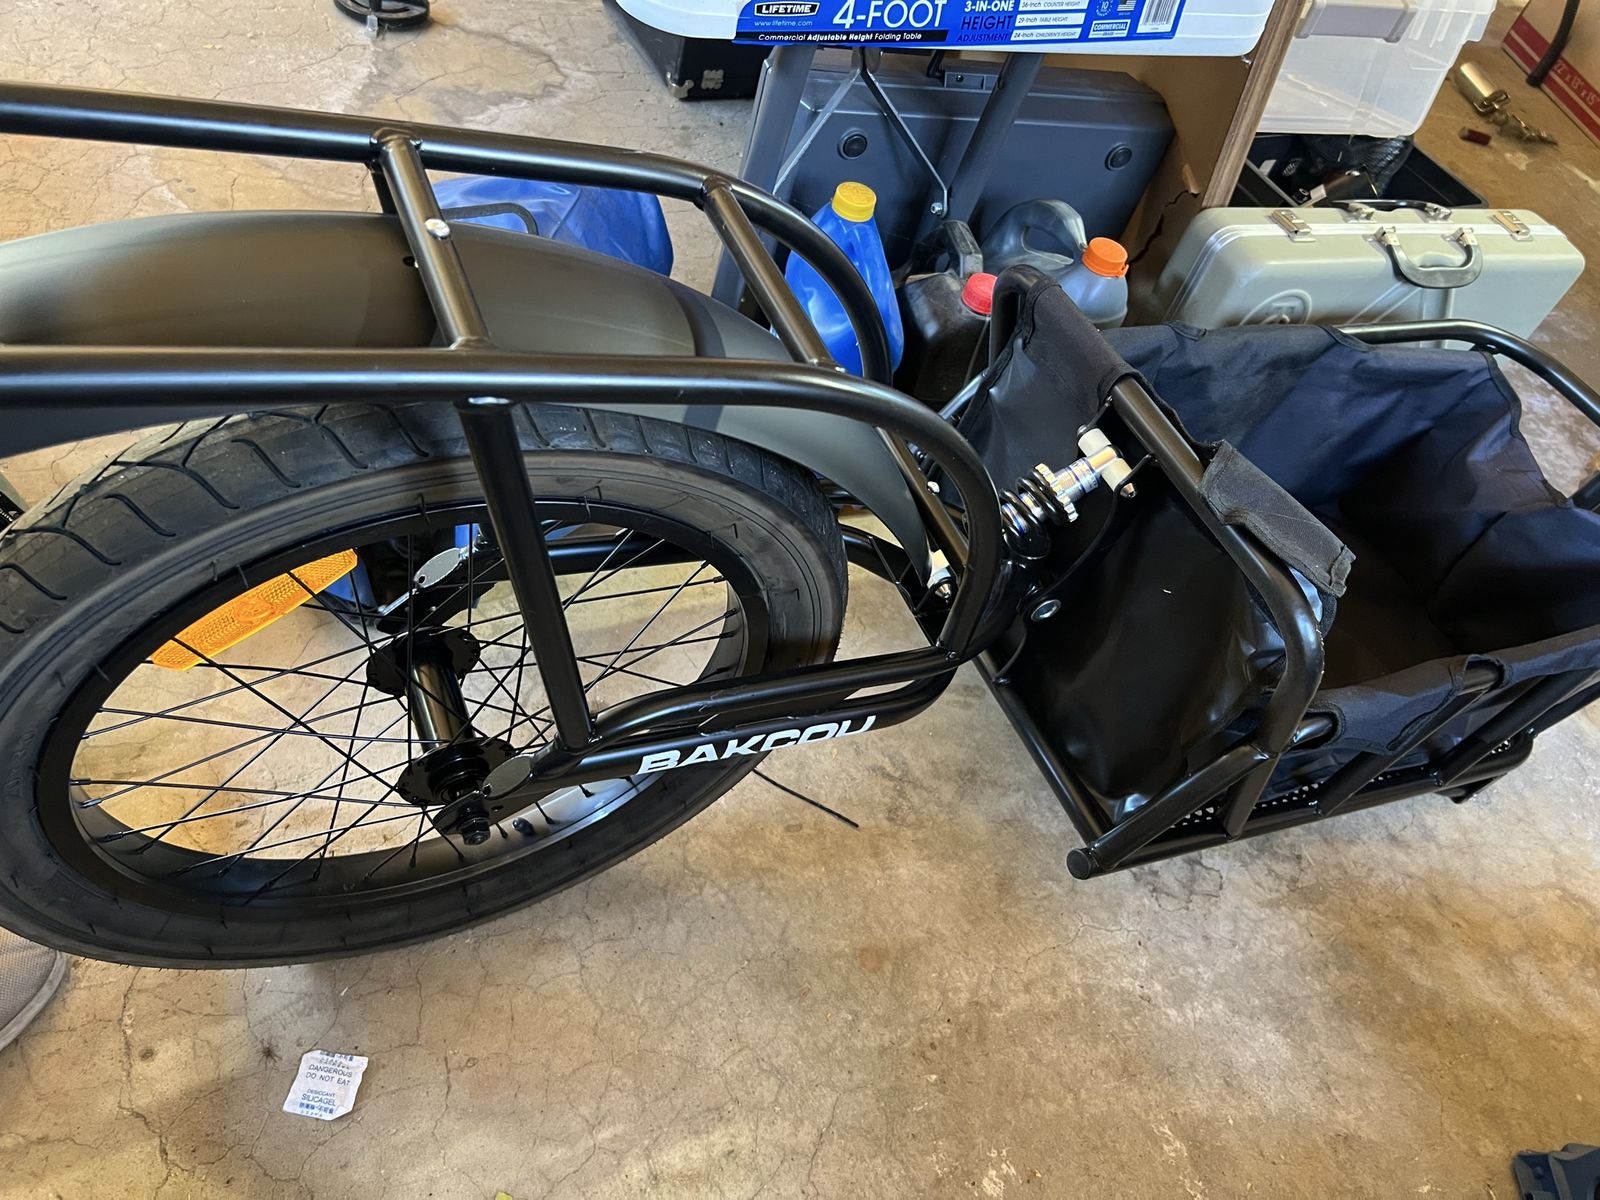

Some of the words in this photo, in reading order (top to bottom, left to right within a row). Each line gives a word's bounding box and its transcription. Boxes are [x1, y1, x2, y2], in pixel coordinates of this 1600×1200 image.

[761, 4, 812, 14] LIFETIME
[964, 0, 1016, 12] 3-IN-ONE
[832, 0, 948, 29] 4-FOOT
[961, 15, 1014, 31] HEIGHT
[807, 34, 847, 42] Adjustable
[848, 33, 873, 42] Height
[874, 33, 902, 41] Folding
[902, 32, 922, 40] Table
[956, 33, 1009, 42] ADJUSTMENT
[636, 714, 877, 775] BAKCOU
[309, 1064, 352, 1077] DANGEROUS
[336, 1078, 351, 1087] EAT
[301, 1093, 336, 1107] SILICAGEL
